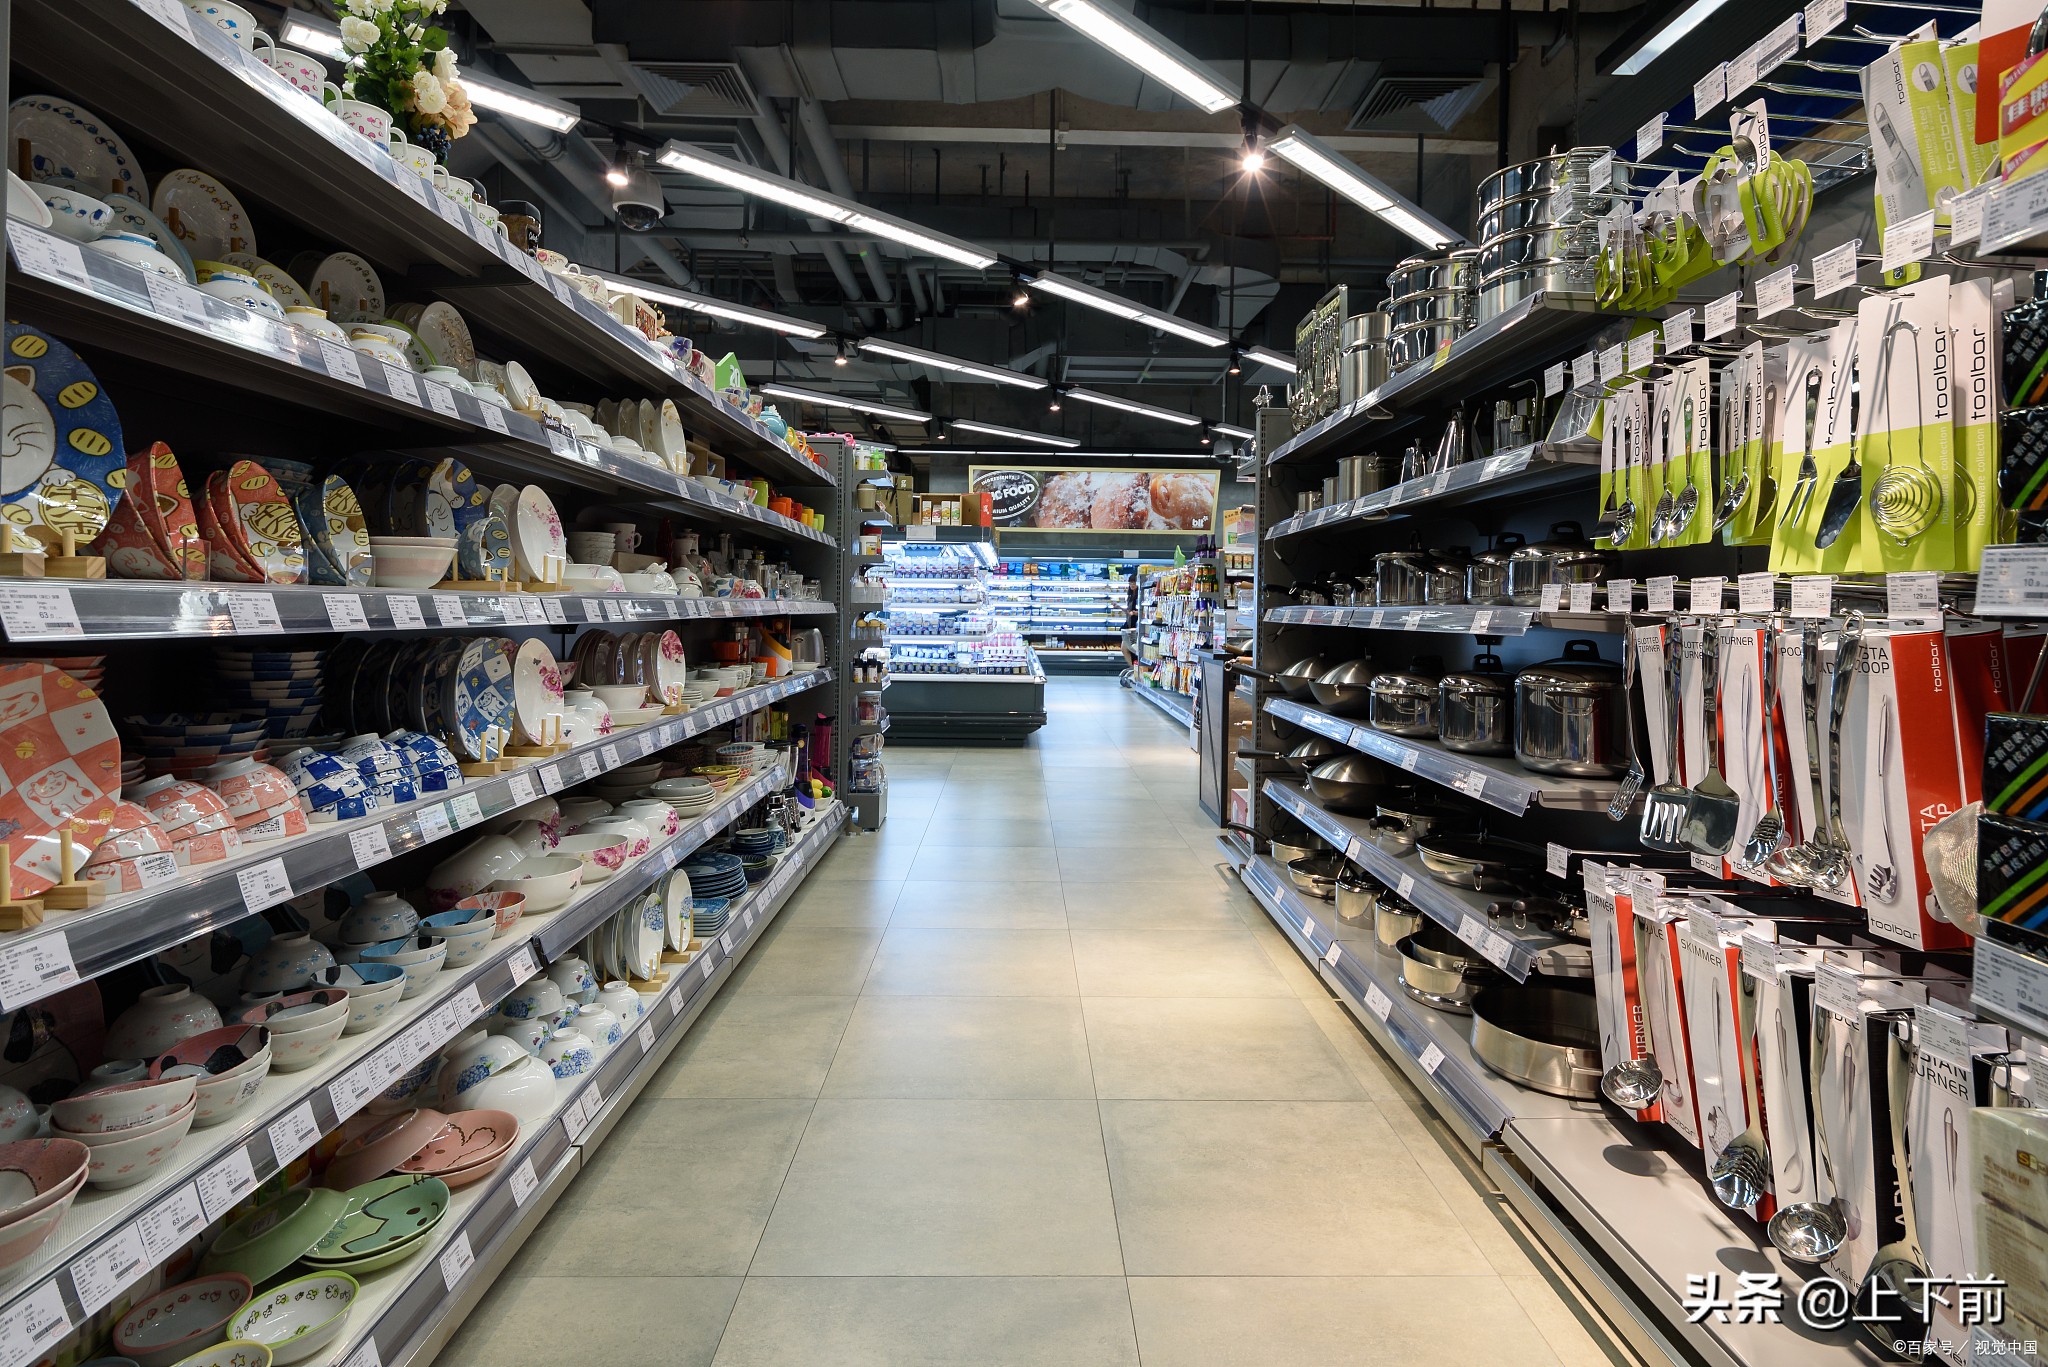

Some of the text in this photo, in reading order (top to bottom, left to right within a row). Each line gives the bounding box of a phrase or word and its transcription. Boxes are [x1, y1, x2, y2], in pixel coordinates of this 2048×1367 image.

[1933, 326, 1949, 419] toolbar
[1970, 328, 1986, 421] toolbar
[1699, 379, 1708, 449] toolbar
[1003, 483, 1035, 498] FOOD
[1009, 495, 1031, 512] QUALITY
[1638, 644, 1660, 653] TURNER
[1721, 635, 1754, 646] TURNER
[1930, 642, 1943, 693] toolbar
[1989, 643, 2001, 694] toolbar
[1692, 855, 1721, 872] toolbar
[1870, 917, 1918, 941] toolbar
[1680, 938, 1722, 968] SKIMMER
[1632, 1003, 1648, 1061] TURNER
[1916, 1064, 1969, 1100] URNER
